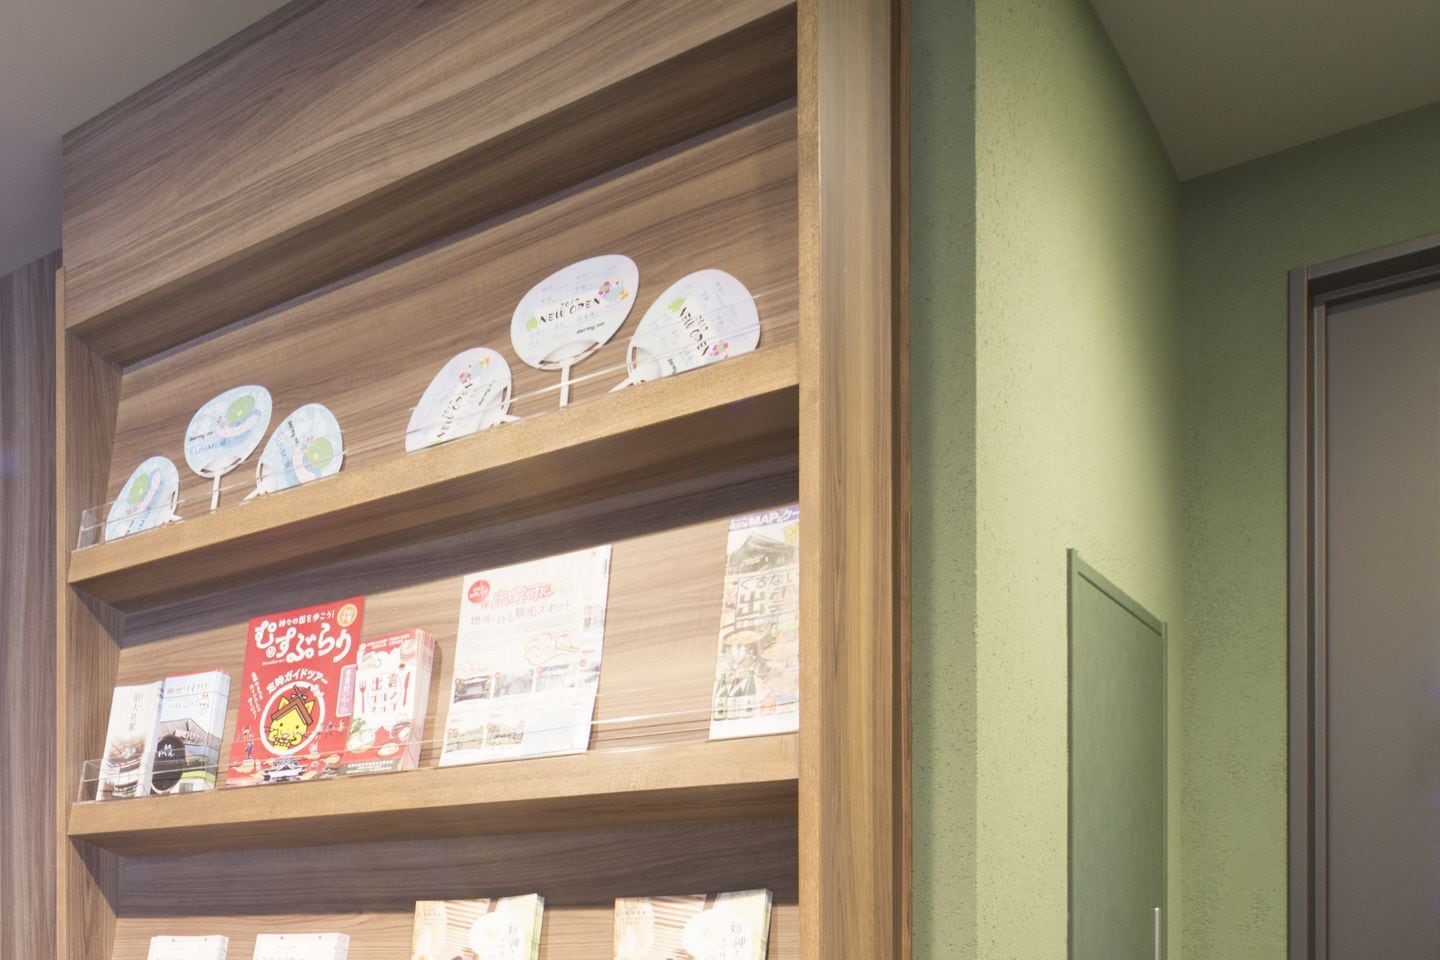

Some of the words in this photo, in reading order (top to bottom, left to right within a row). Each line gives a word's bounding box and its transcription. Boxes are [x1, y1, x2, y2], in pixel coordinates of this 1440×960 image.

[569, 298, 601, 315] OPEN
[255, 620, 352, 664] むすぶらり
